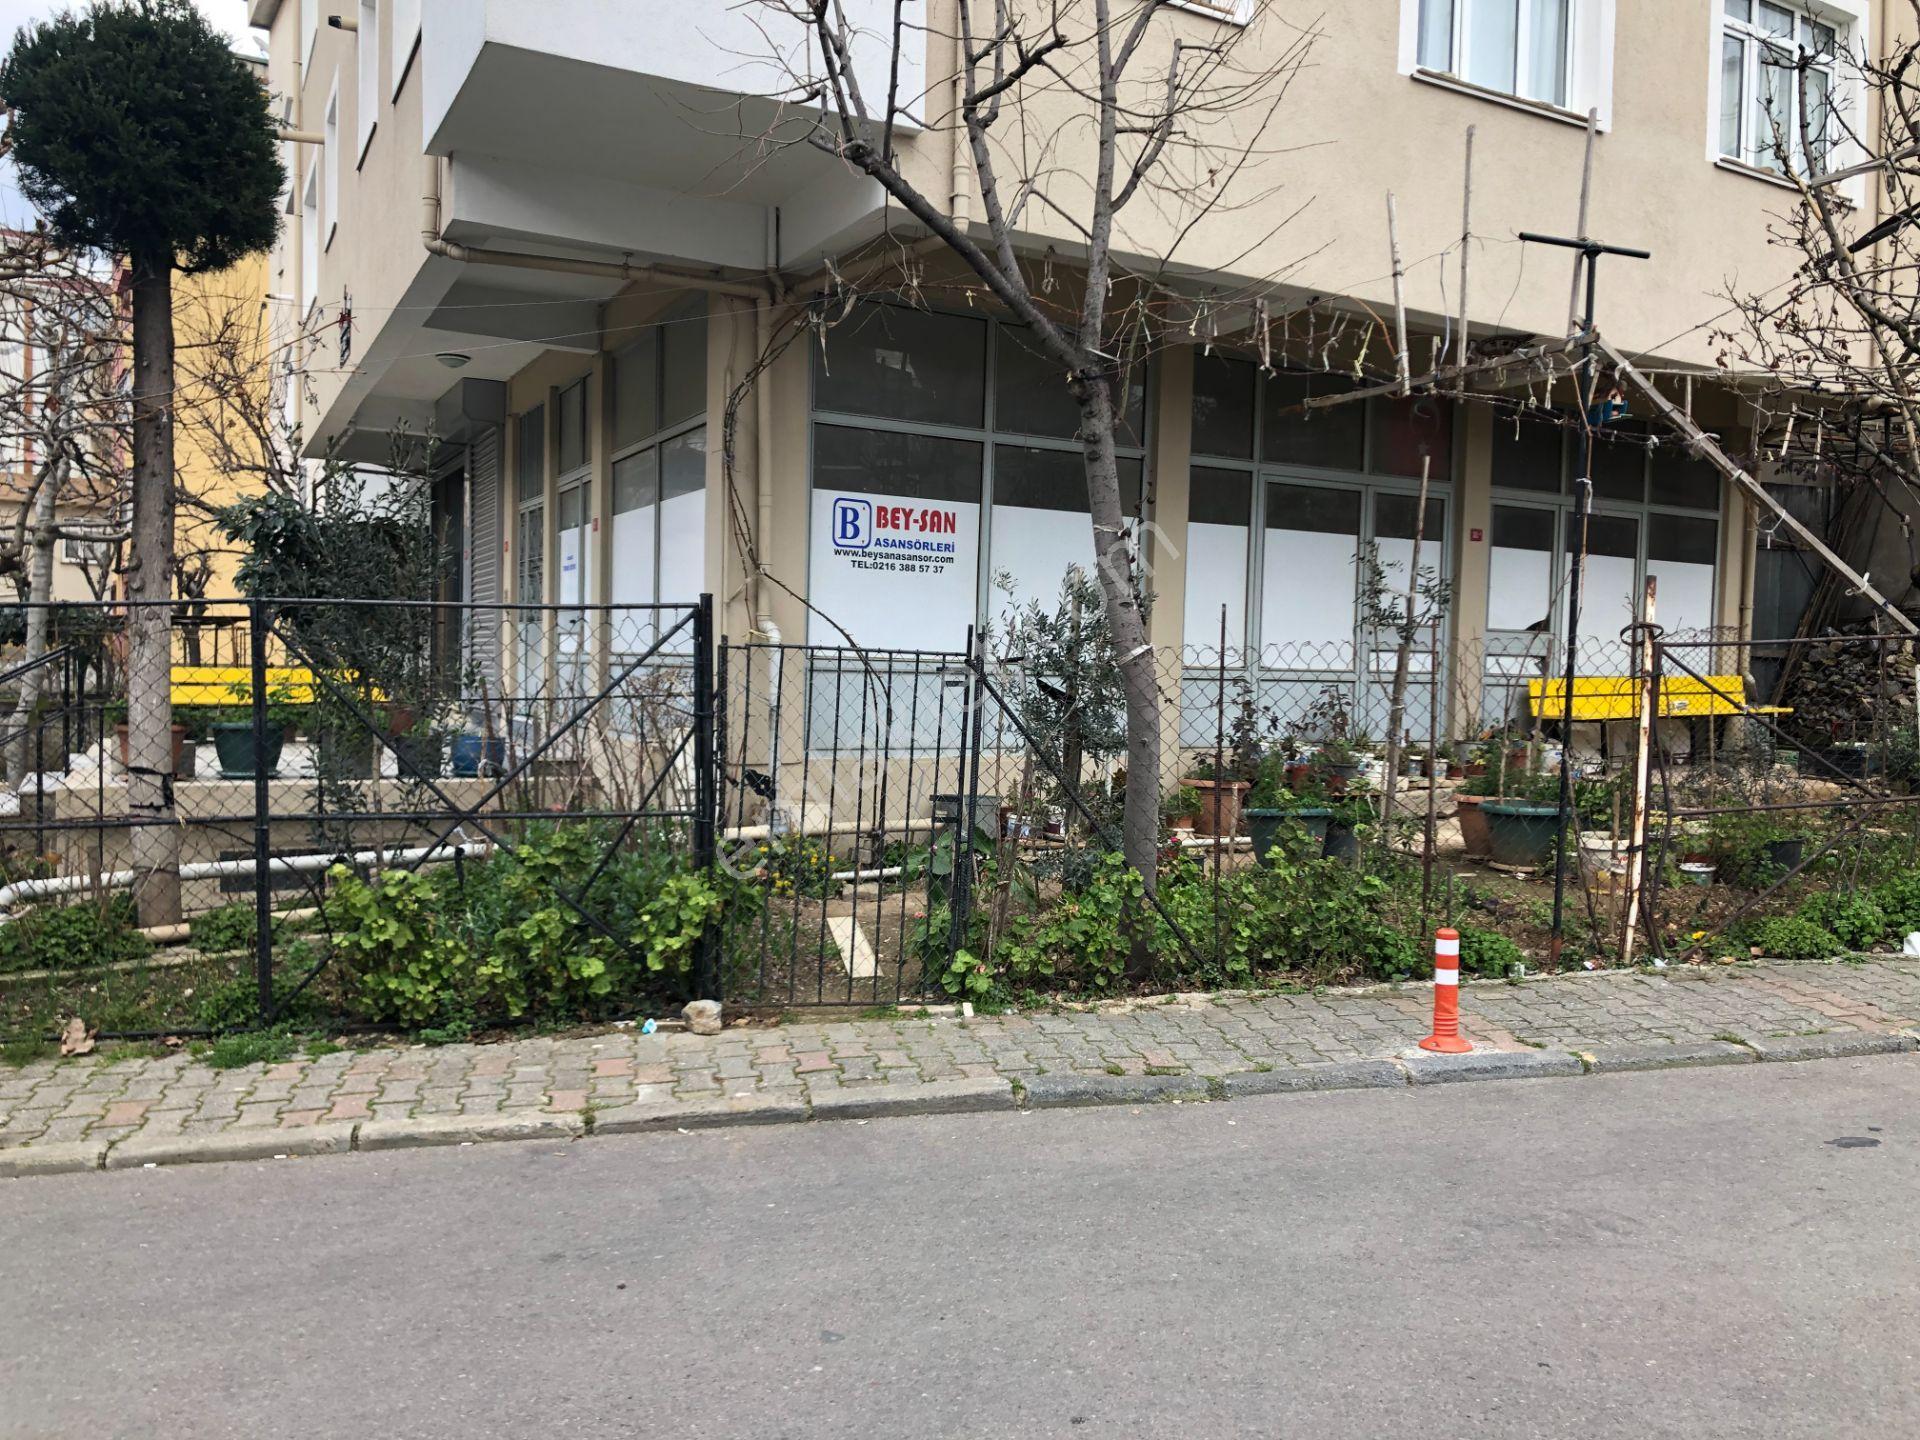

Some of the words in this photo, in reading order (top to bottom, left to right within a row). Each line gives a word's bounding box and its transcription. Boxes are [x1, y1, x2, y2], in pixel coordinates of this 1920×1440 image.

[838, 506, 861, 540] B
[876, 505, 956, 534] BEY-SAN
[874, 538, 955, 553] ASANSÖRLERİ
[834, 548, 954, 564] www.beysanasansor.com
[851, 560, 896, 571] TEL:0216
[899, 563, 916, 573] 388
[919, 565, 930, 573] 57
[933, 565, 944, 574] 37
